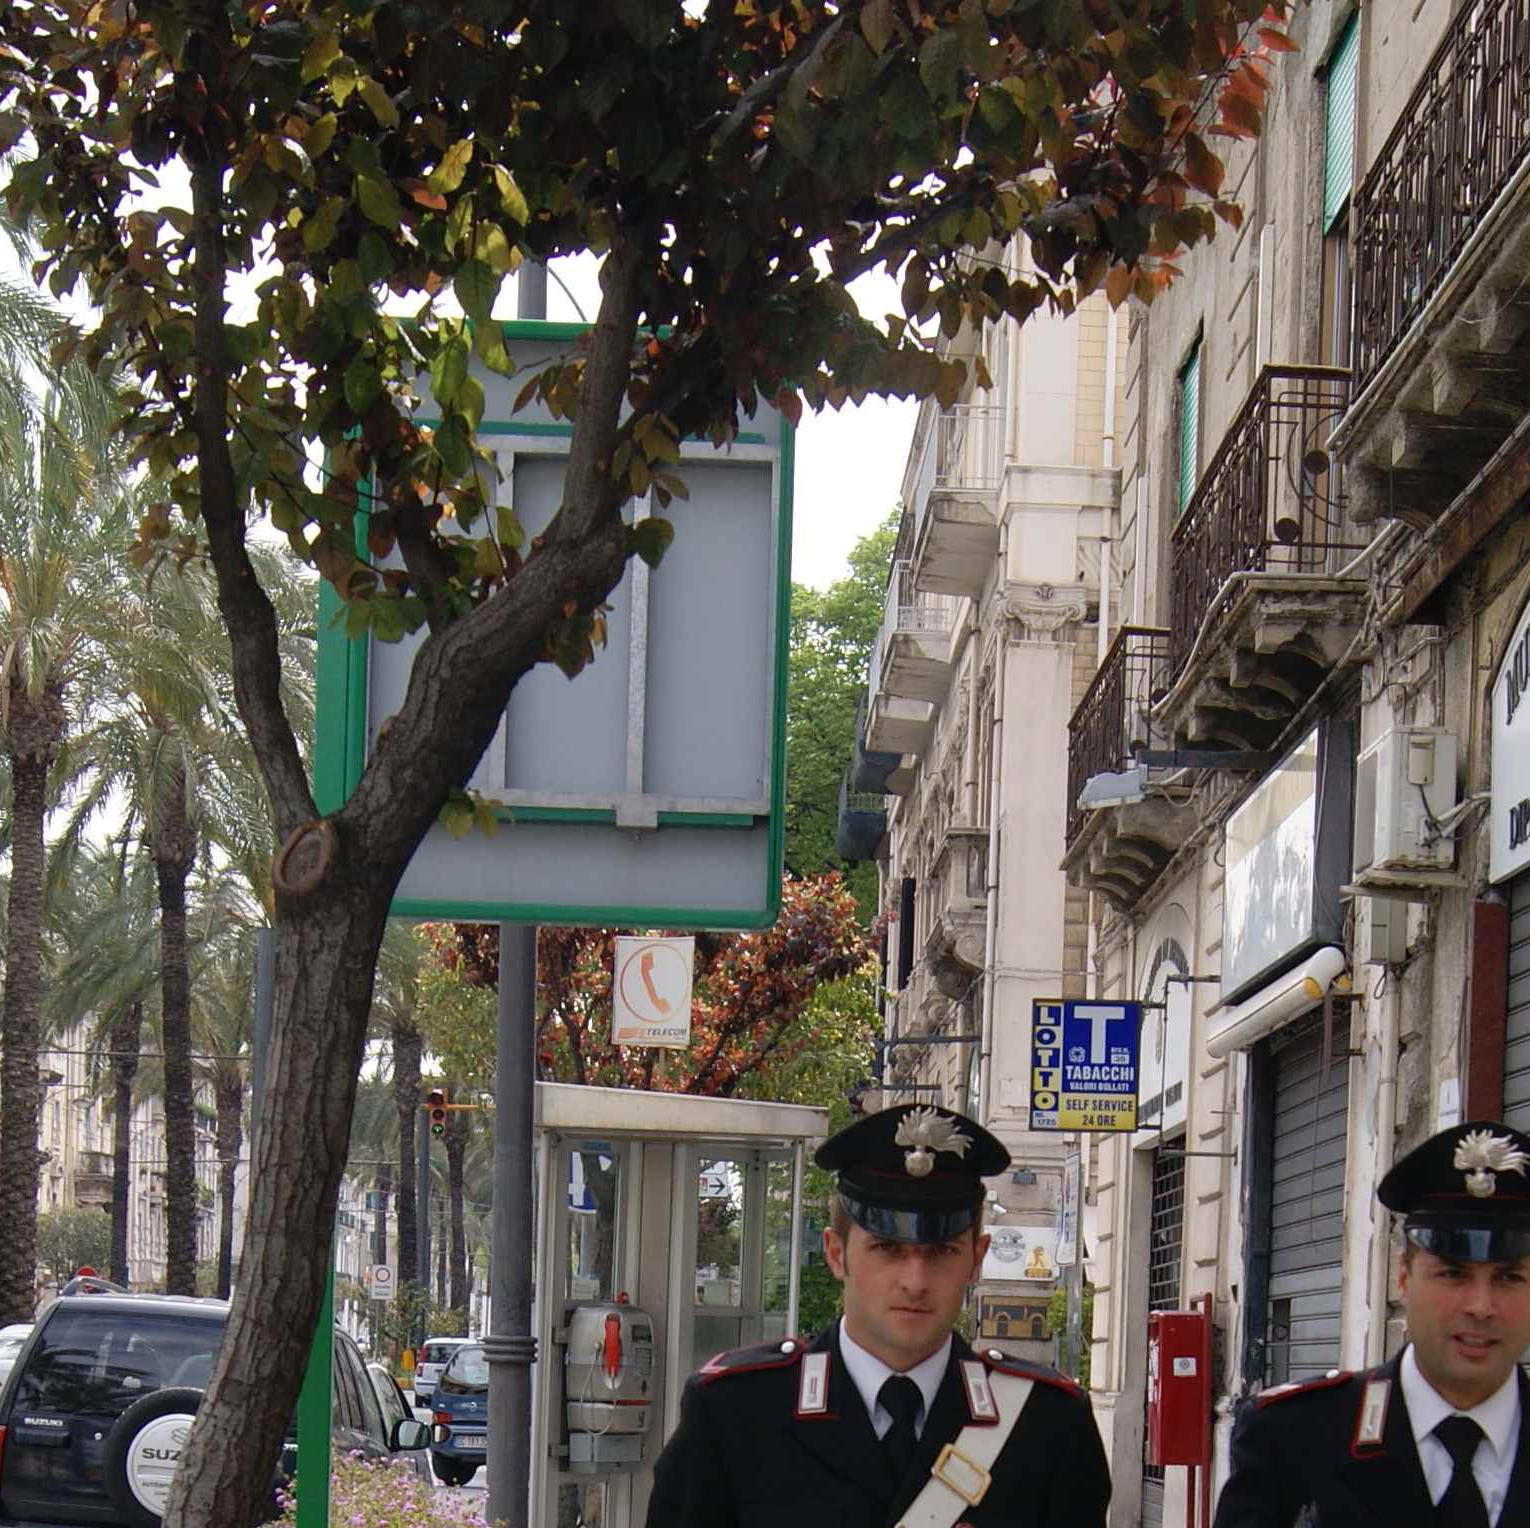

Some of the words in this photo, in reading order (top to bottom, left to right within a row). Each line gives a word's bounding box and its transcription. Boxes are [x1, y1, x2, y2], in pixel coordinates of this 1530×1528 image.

[646, 1027, 686, 1036] TELECOM
[1074, 1005, 1125, 1064] T
[1035, 1006, 1057, 1110] LOTTO
[1065, 1066, 1134, 1081] TABACCHI
[1070, 1081, 1096, 1091] VALORI
[1098, 1082, 1129, 1092] BOLLATI
[1066, 1098, 1089, 1110] SELF
[1092, 1099, 1133, 1112] SERVICE
[1082, 1114, 1094, 1126] 24
[1097, 1115, 1116, 1126] ORE
[24, 1417, 63, 1427] SUZUKI
